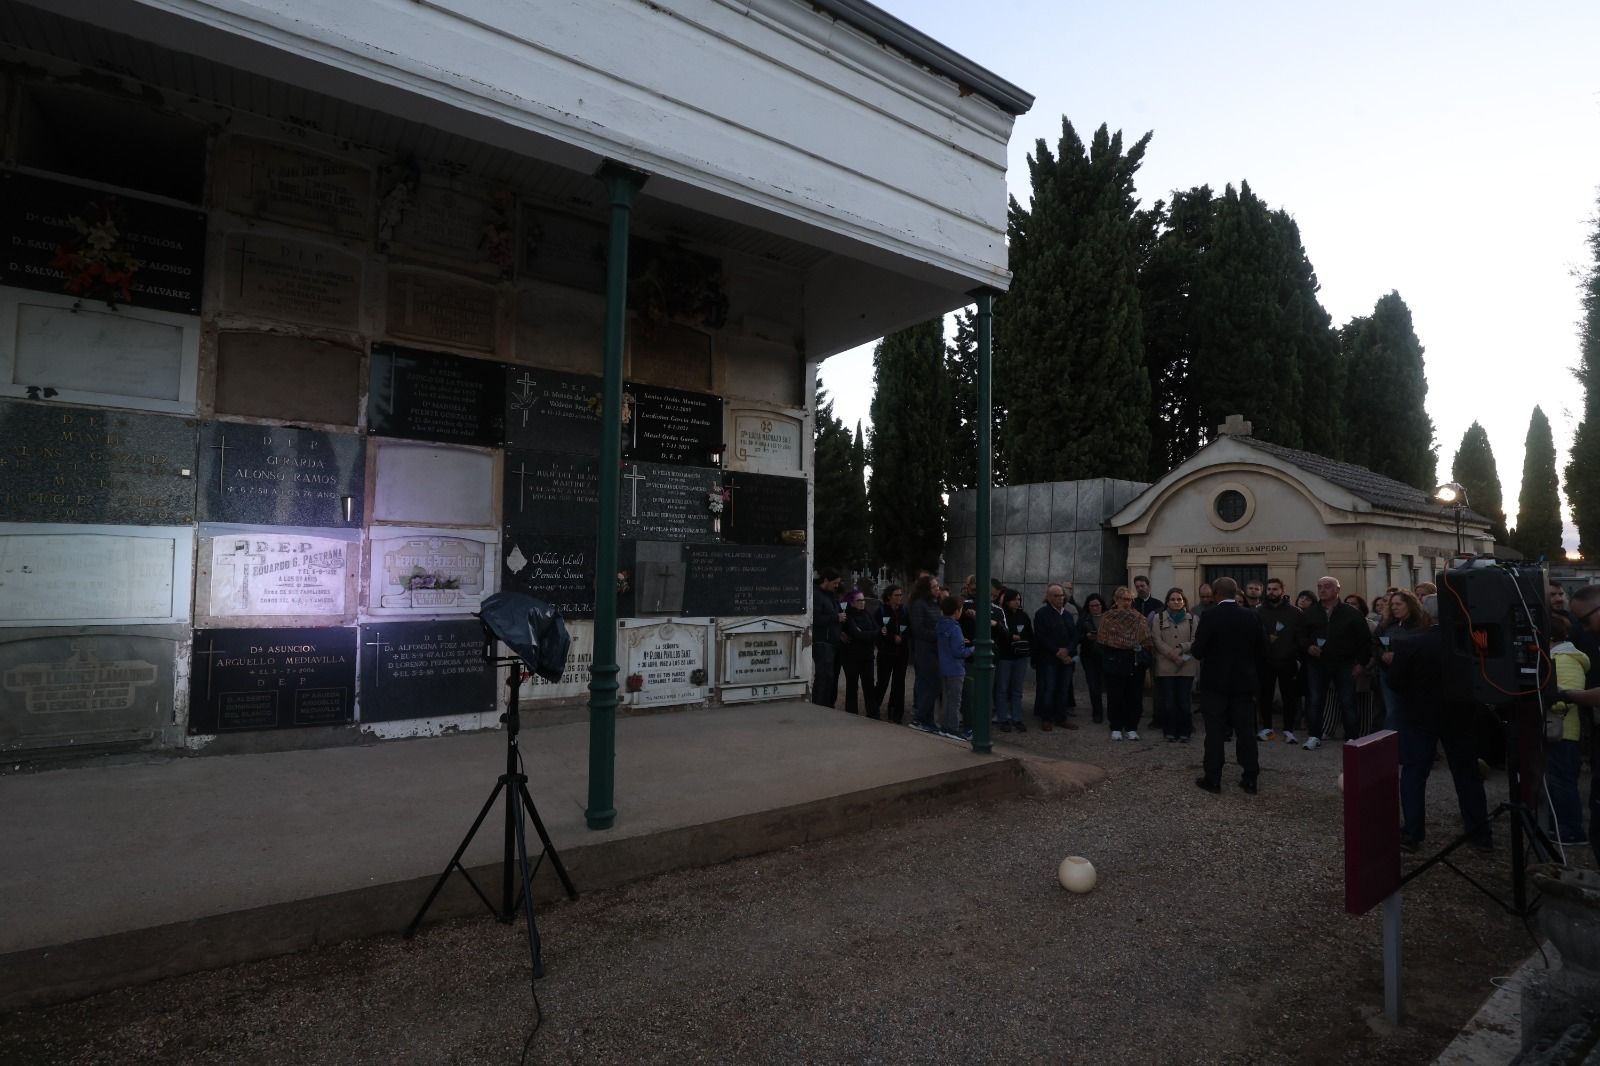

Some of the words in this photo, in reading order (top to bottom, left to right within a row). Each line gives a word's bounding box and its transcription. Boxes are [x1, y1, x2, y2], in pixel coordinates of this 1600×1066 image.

[9, 261, 21, 273] D.
[149, 262, 192, 277] ALONSO
[146, 284, 192, 301] ALVAREZ
[266, 455, 325, 469] GERARDA
[235, 468, 285, 482] ALONSO
[294, 473, 337, 485] RAMOS
[1245, 544, 1288, 553] SAMPEDRO
[267, 644, 317, 654] ASUNCION
[215, 658, 276, 668] ARGUELLO
[285, 655, 346, 666] MEDIAVILLA
[395, 661, 429, 669] LORENZO
[751, 687, 760, 697] D.
[763, 686, 771, 696] E.
